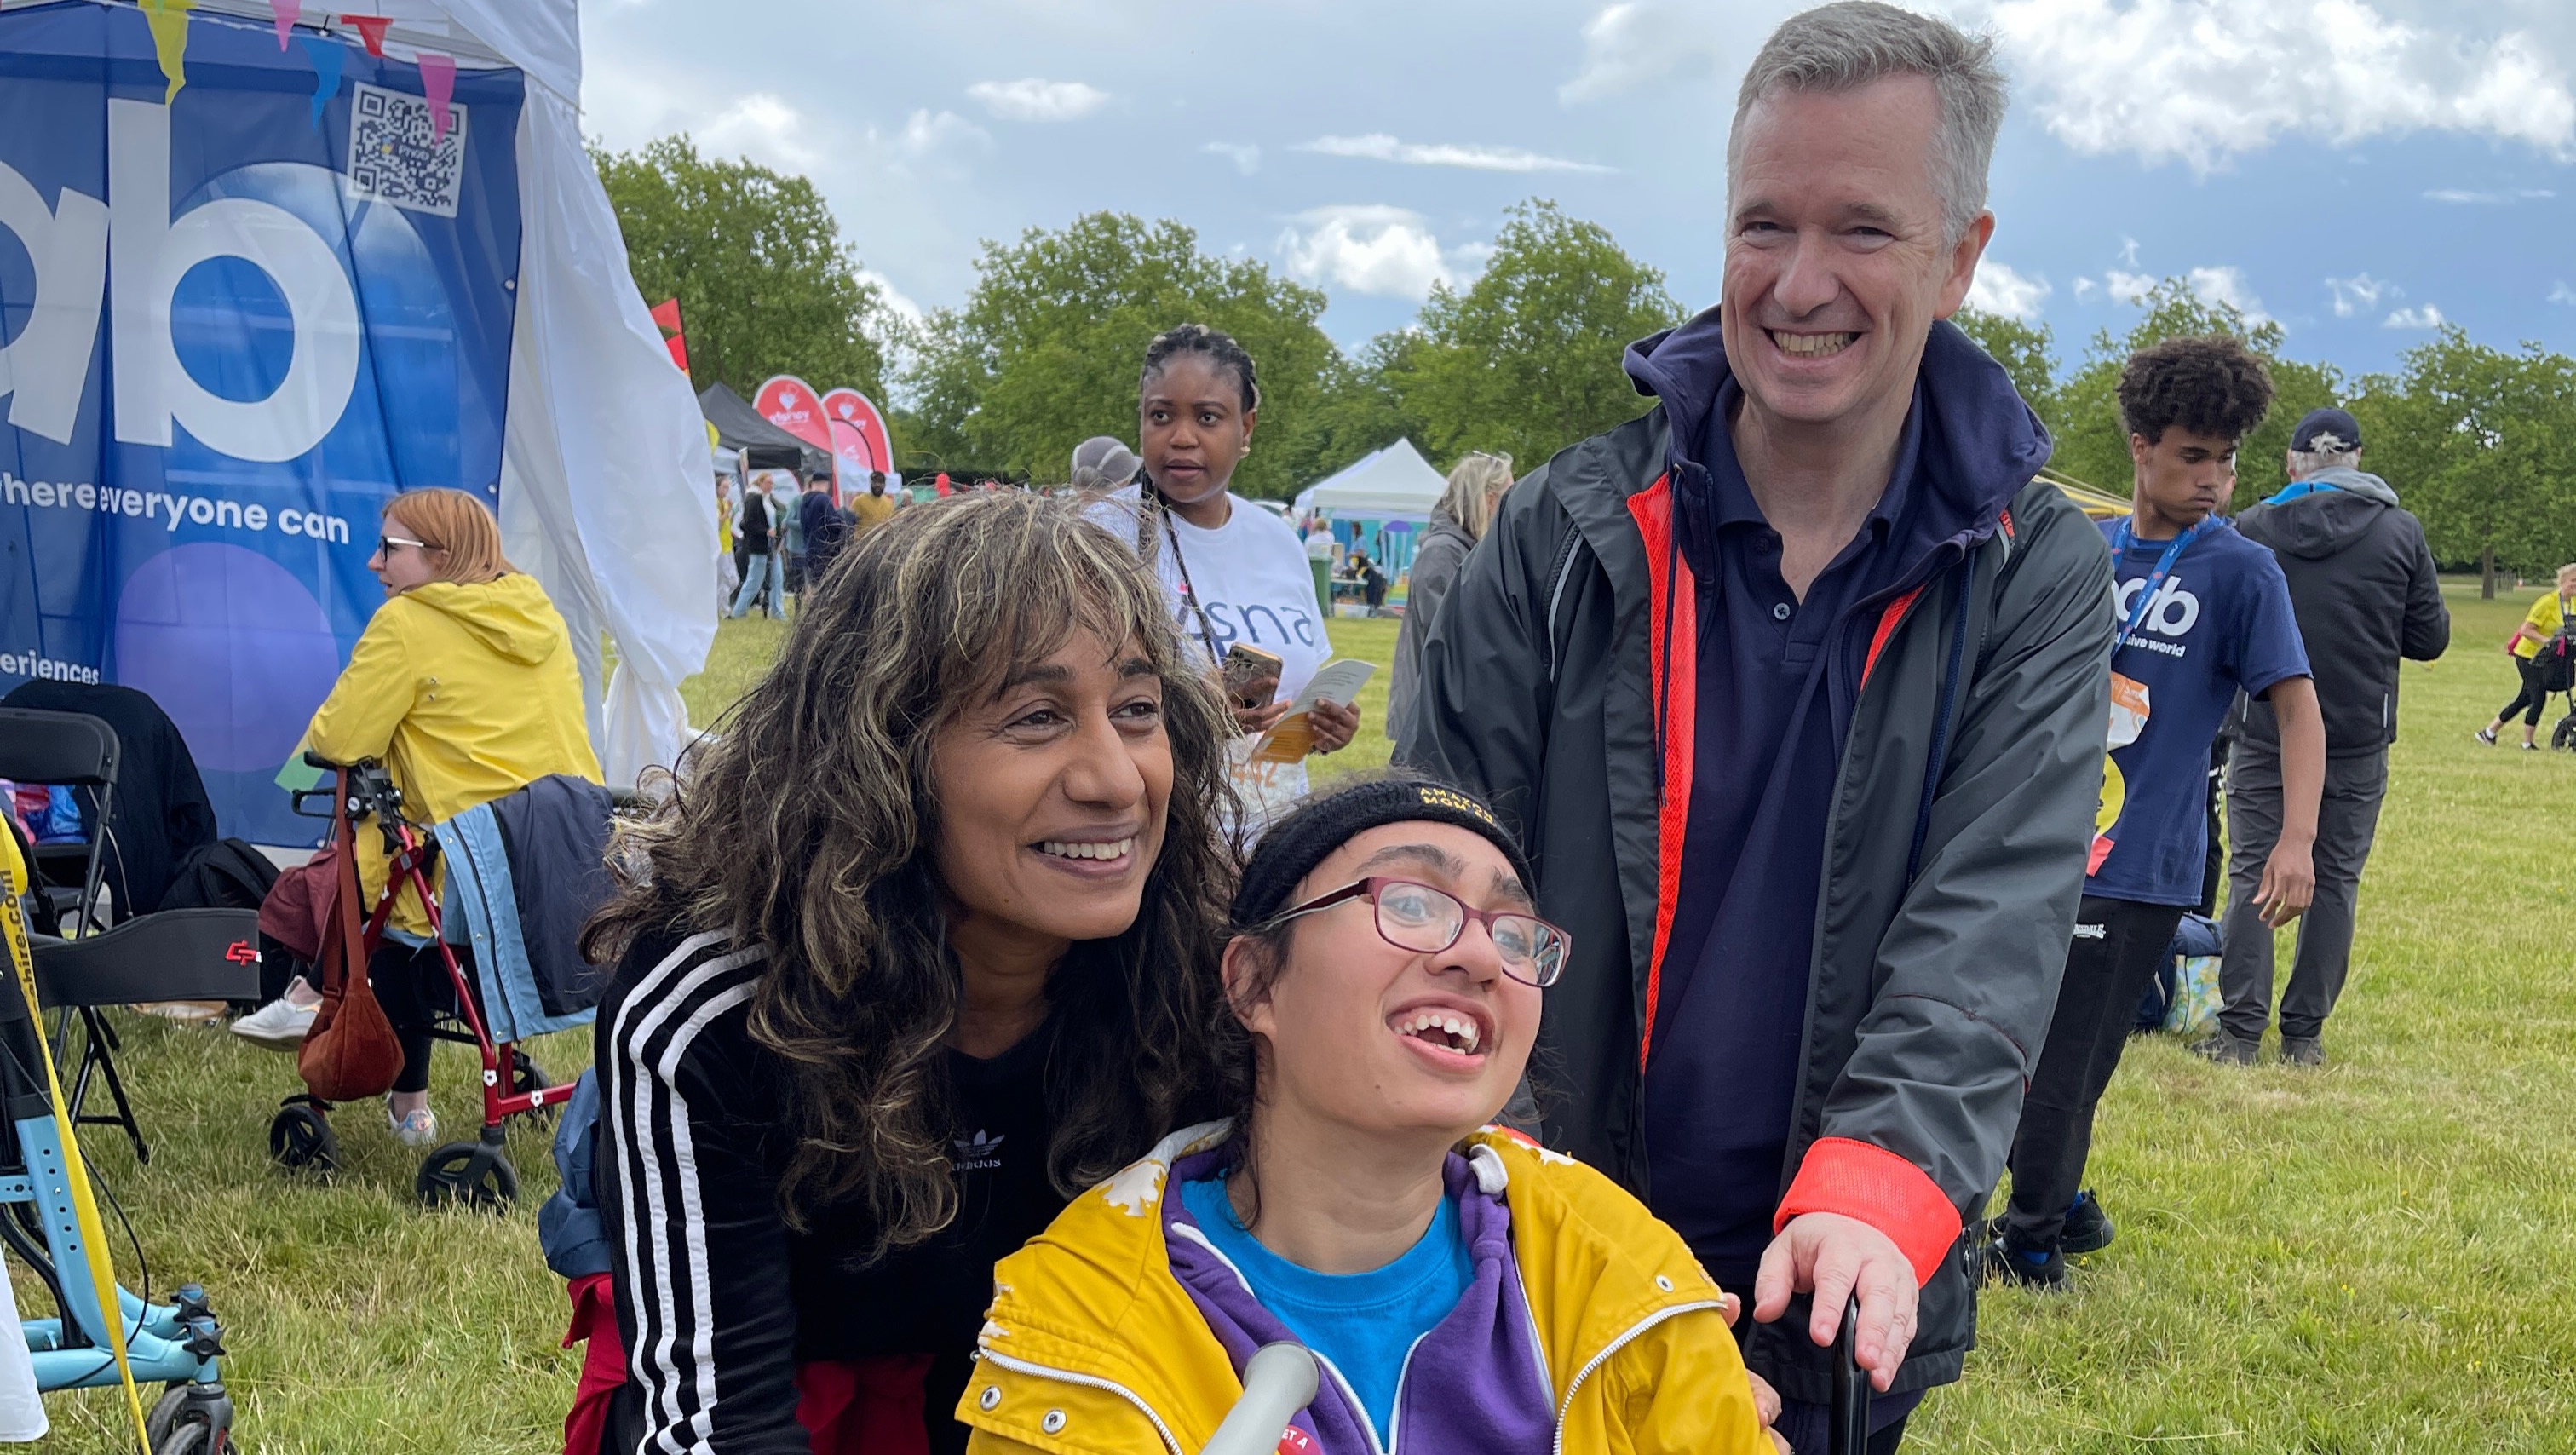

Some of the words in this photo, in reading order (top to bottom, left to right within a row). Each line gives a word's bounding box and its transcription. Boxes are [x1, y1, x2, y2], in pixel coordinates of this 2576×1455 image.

[0, 472, 96, 510] here
[100, 486, 268, 532] everyone
[278, 508, 350, 545] can
[2111, 576, 2199, 636] ab
[2148, 639, 2187, 658] world
[1297, 1436, 1308, 1449] A
